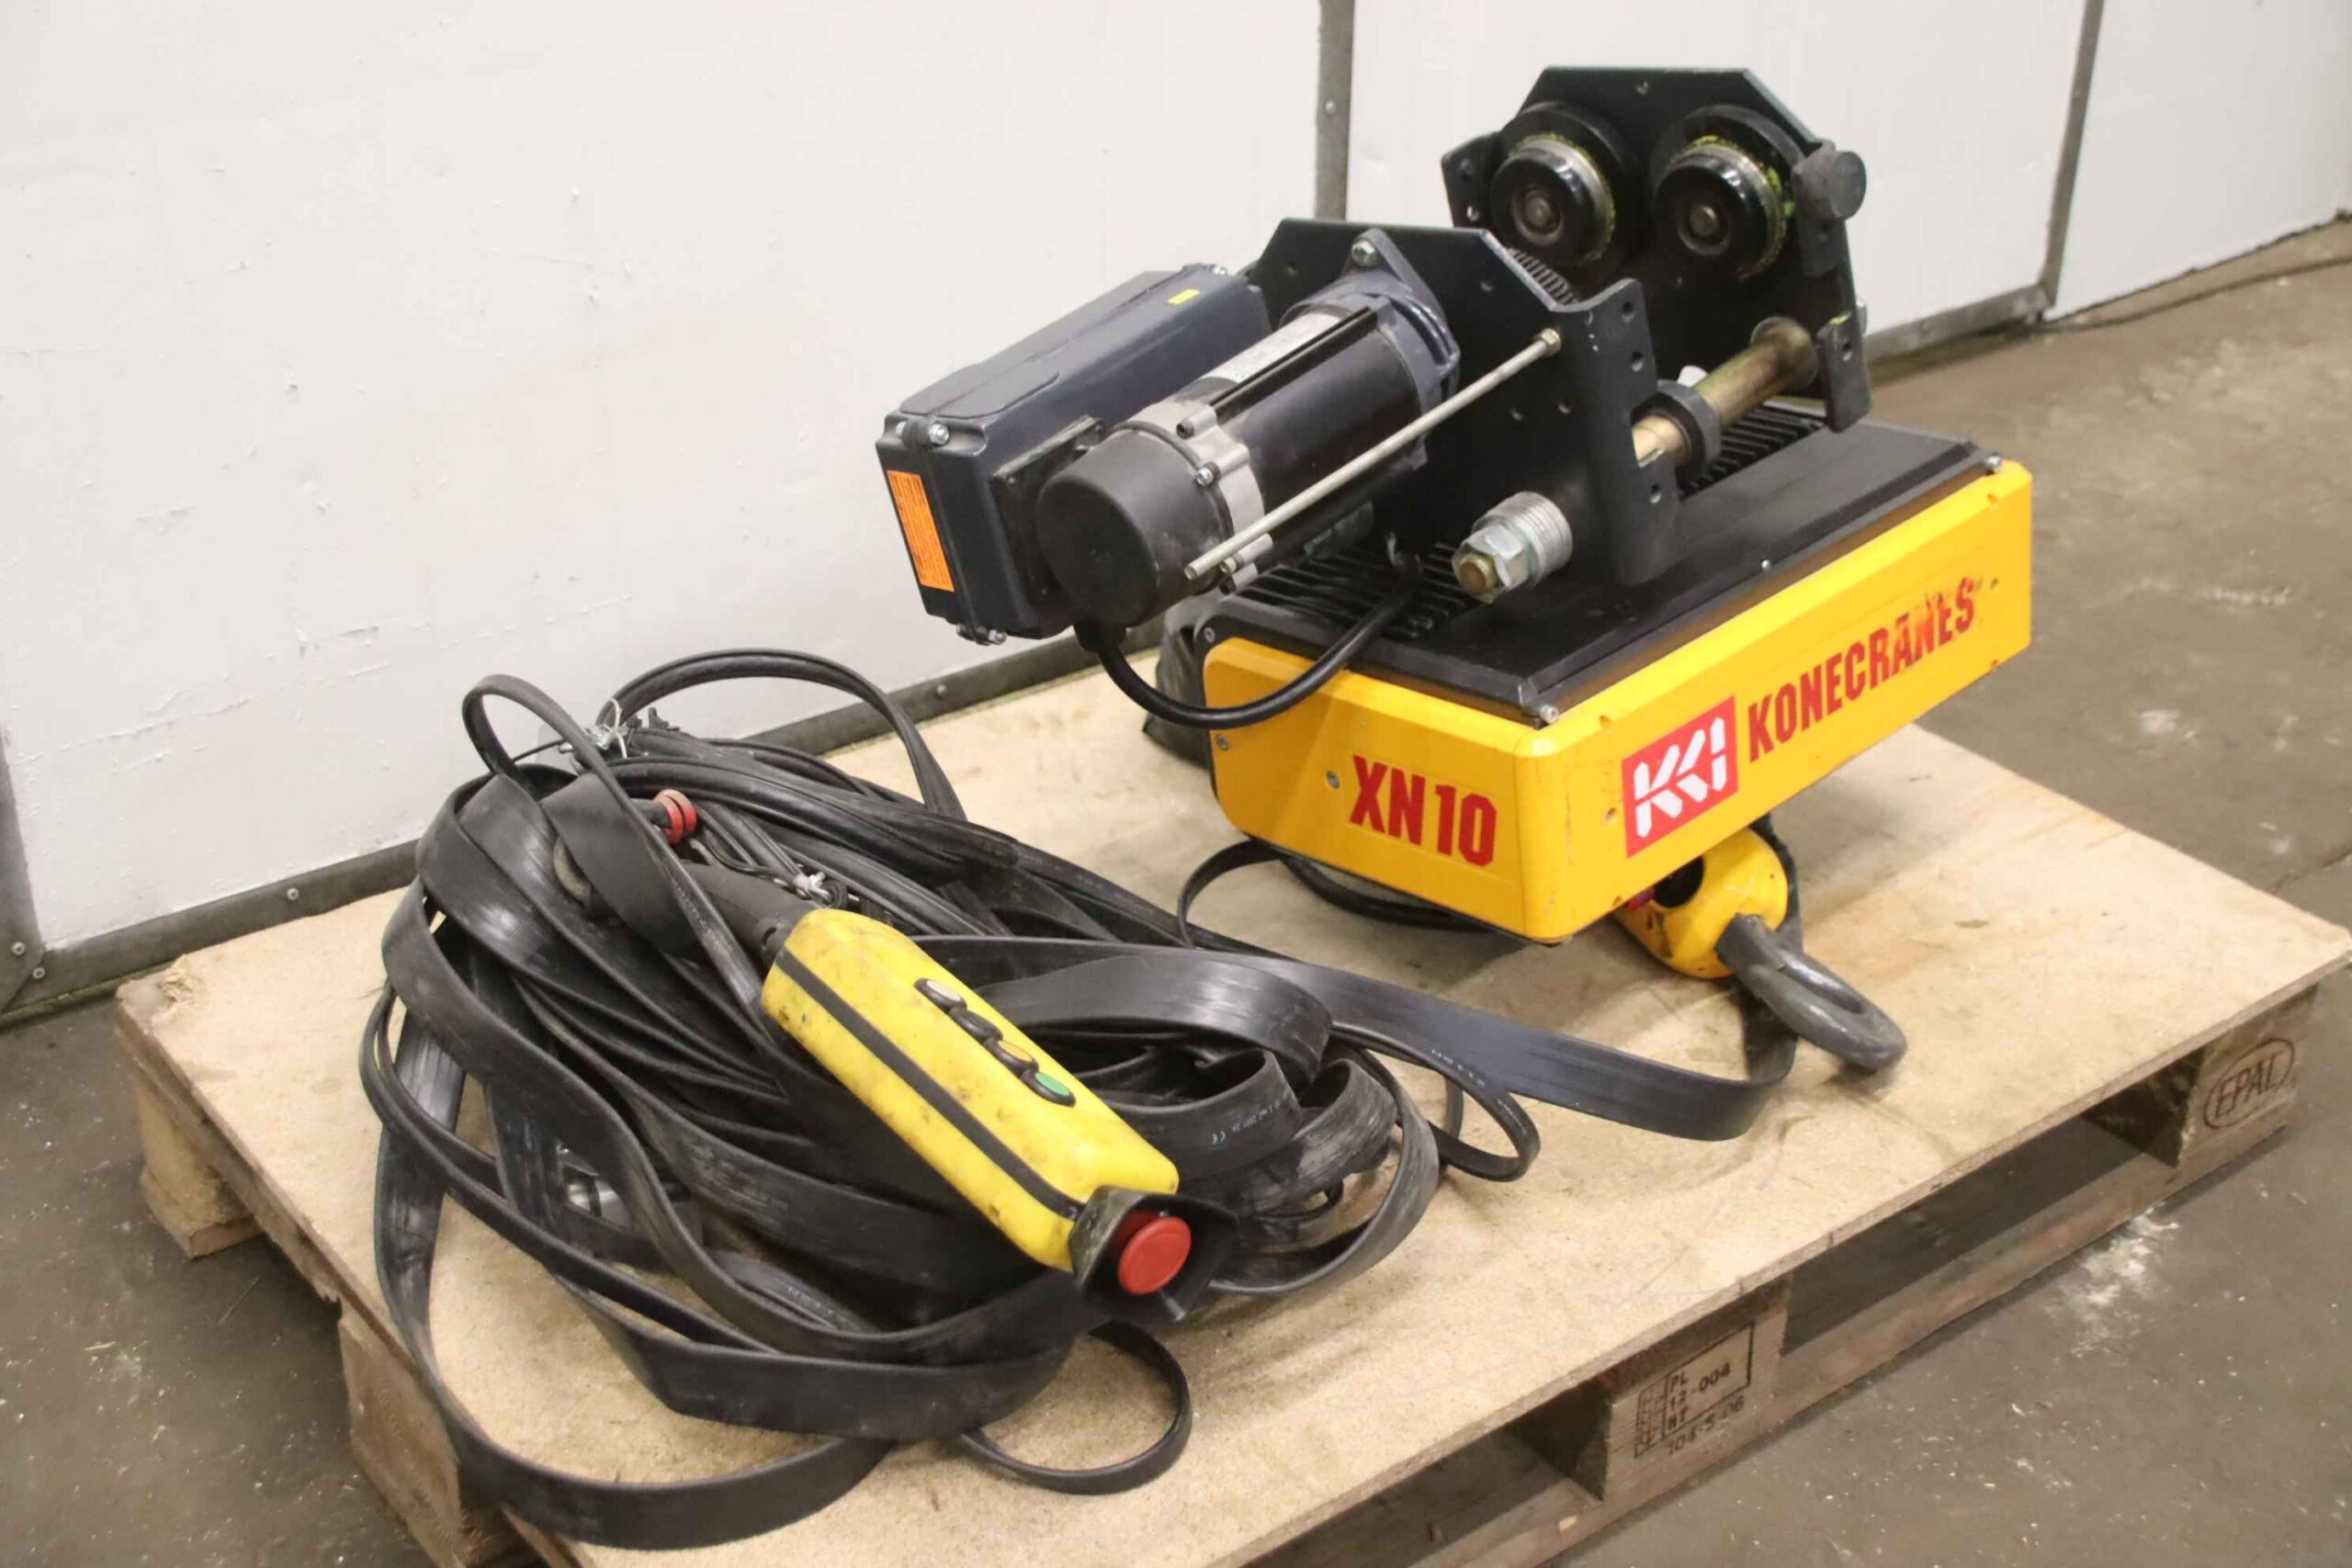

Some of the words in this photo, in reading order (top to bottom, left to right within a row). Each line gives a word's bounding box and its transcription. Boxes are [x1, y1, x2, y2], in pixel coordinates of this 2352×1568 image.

[1747, 576, 1975, 763] KONECRANES
[1349, 753, 1426, 847] XN
[1434, 784, 1498, 868] 10
[2213, 1053, 2280, 1118] EPAL
[1669, 1371, 1689, 1393] PL
